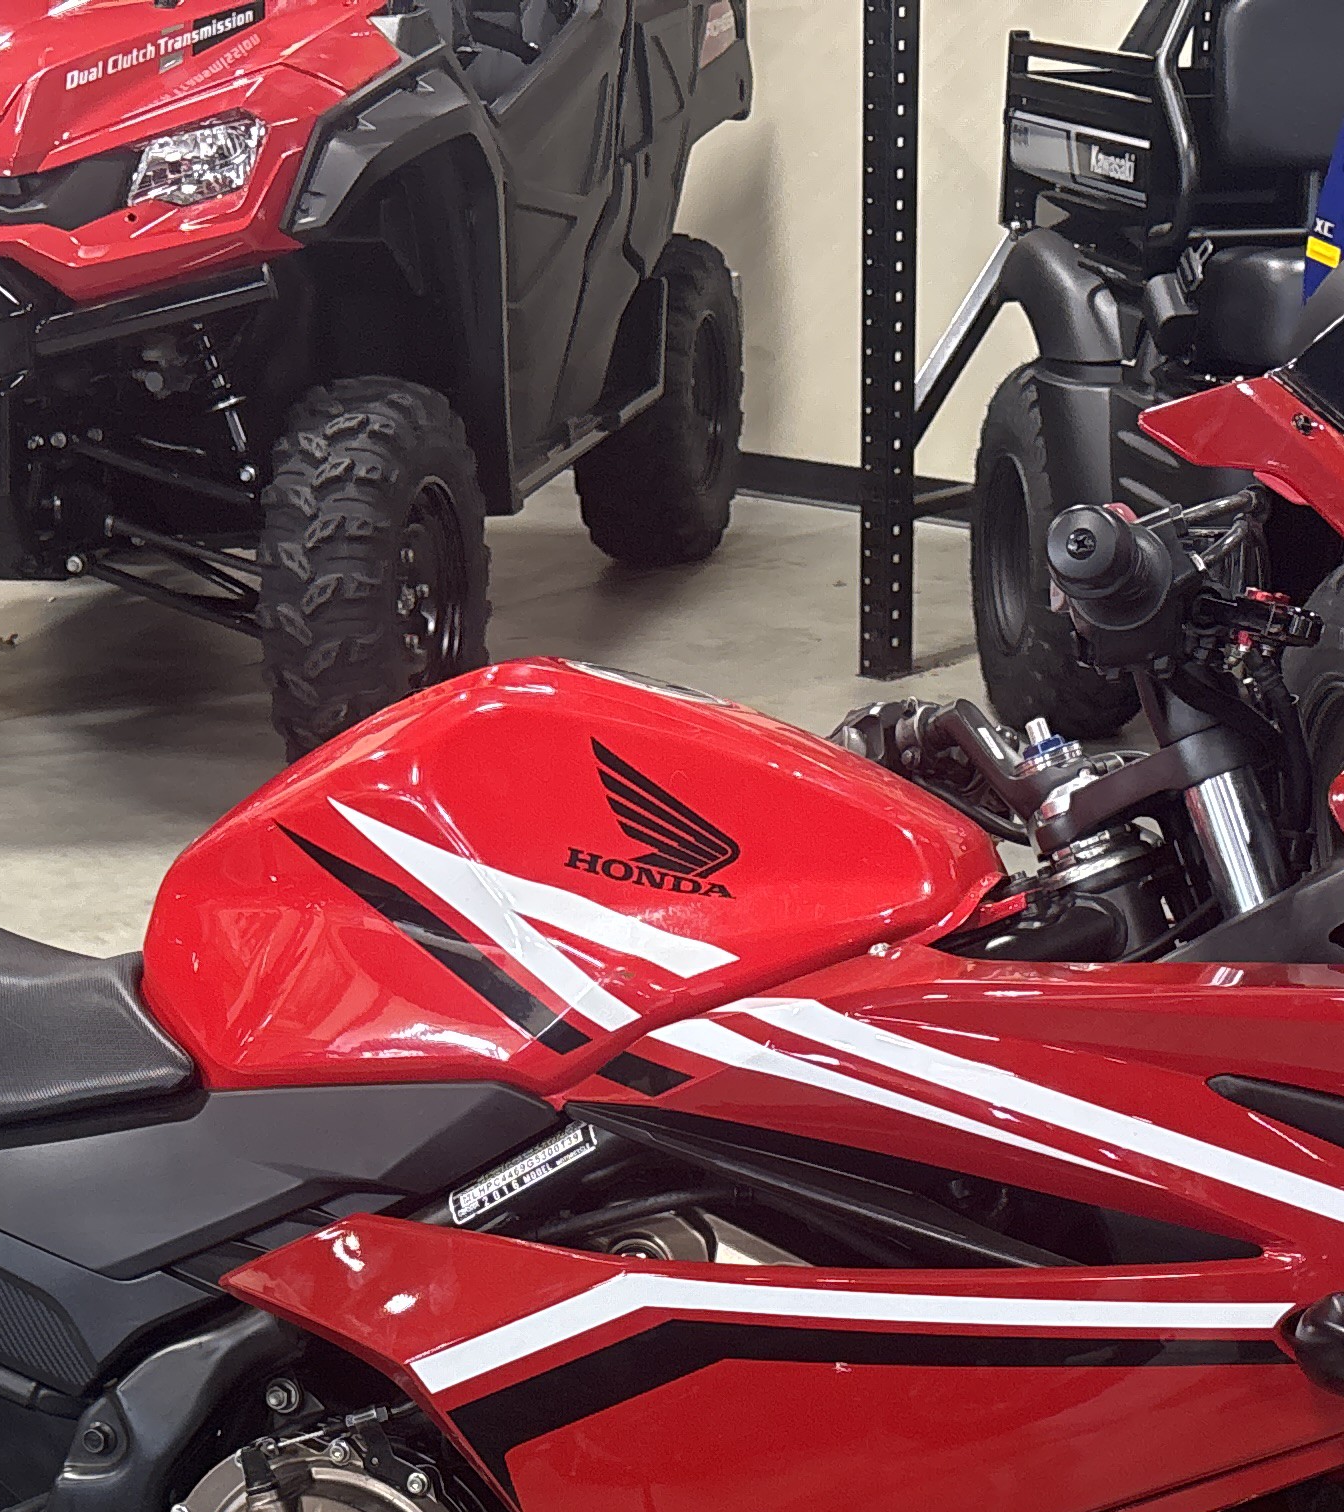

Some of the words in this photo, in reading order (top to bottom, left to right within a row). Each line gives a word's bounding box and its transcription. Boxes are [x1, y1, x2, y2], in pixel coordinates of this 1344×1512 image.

[65, 61, 103, 90] Dual
[107, 44, 155, 73] Clutch
[157, 10, 254, 55] Transmission
[1090, 145, 1137, 183] Kawasaki
[1314, 217, 1335, 239] XC
[564, 847, 736, 899] HONDA
[482, 1180, 520, 1208] 2016
[523, 1162, 553, 1184] MODEL
